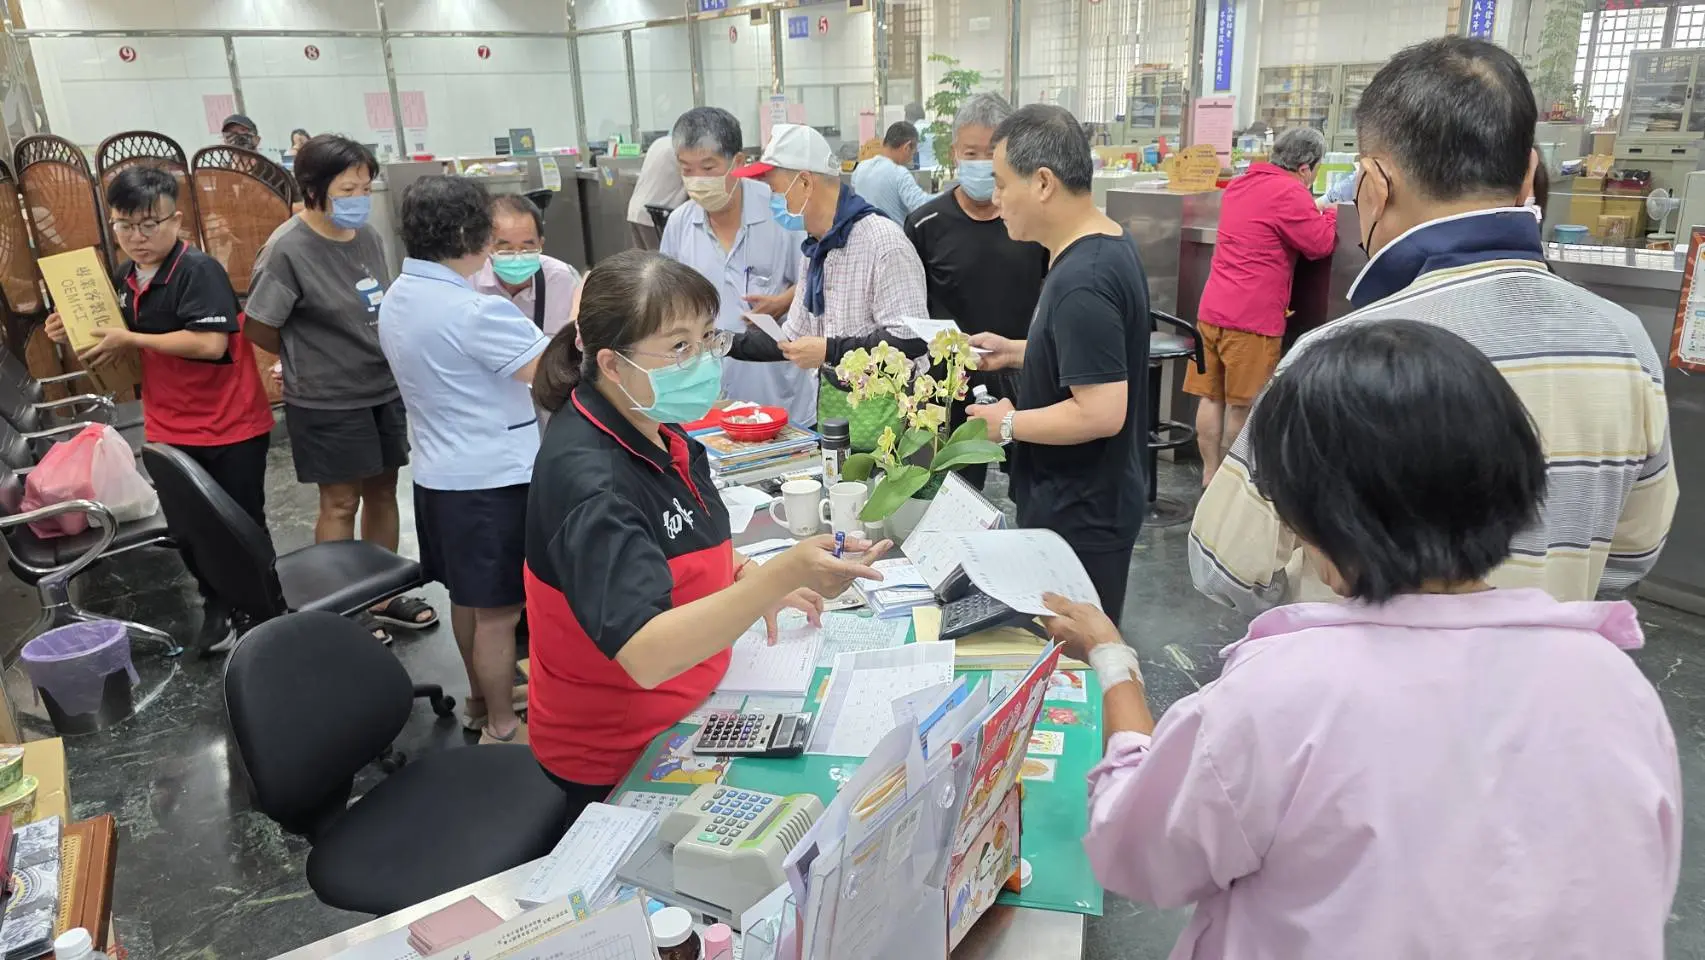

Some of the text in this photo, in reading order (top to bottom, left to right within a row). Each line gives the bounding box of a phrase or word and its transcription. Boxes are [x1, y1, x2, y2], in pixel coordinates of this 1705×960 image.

[121, 46, 135, 62] 9
[306, 45, 319, 60] 8
[478, 46, 489, 59] 7
[61, 279, 90, 323] OEM代工
